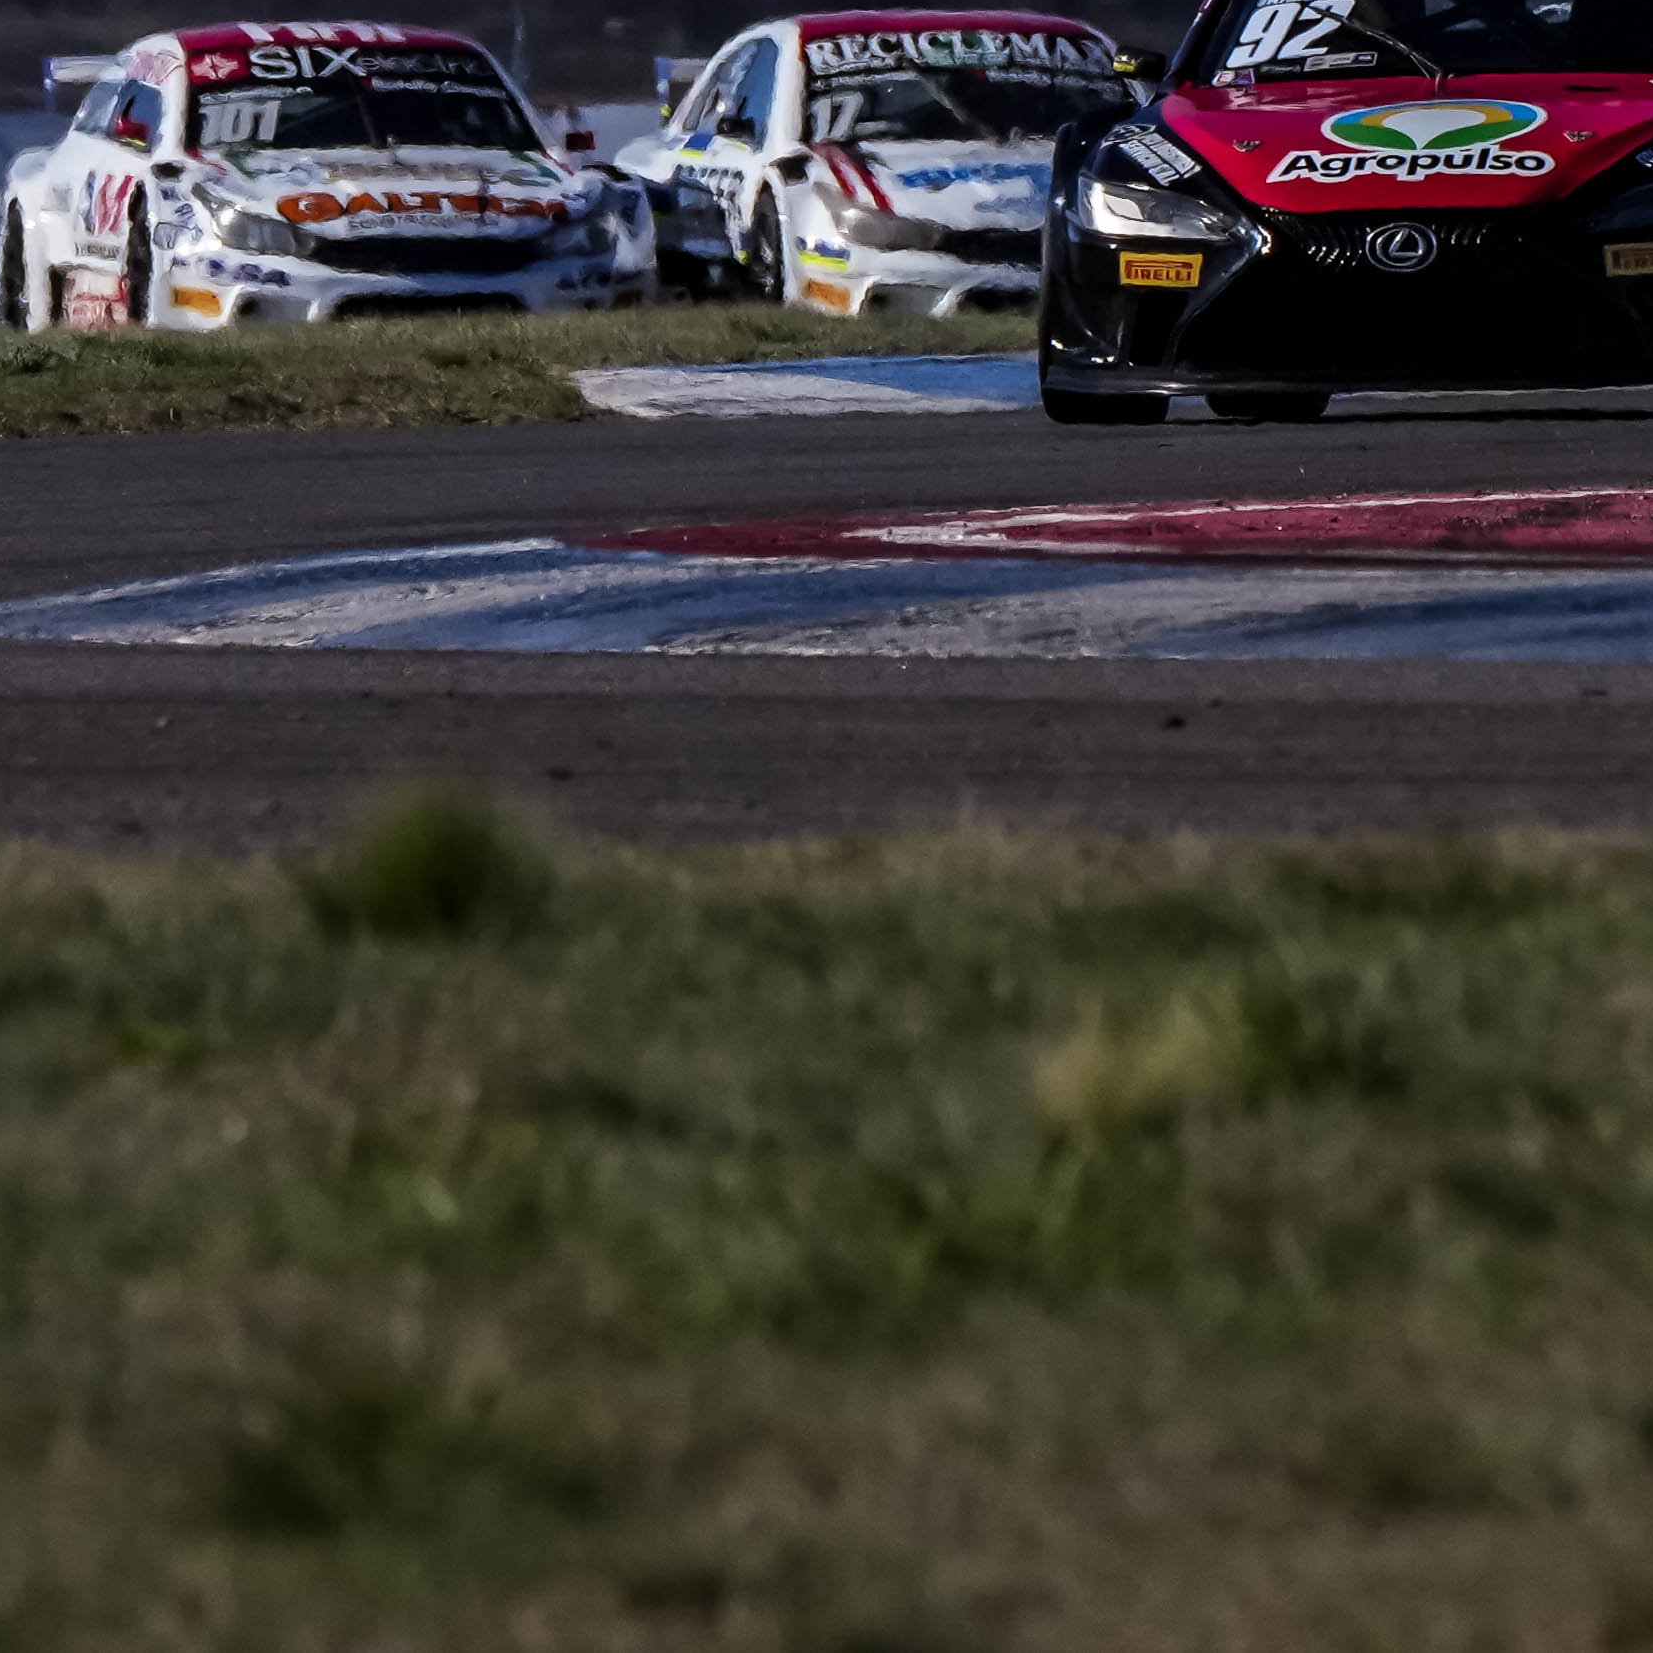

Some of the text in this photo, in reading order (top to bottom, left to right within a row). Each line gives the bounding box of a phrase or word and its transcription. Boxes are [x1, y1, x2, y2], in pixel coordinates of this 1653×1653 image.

[249, 46, 367, 79] SIX
[197, 100, 282, 145] 101
[808, 92, 864, 143] 17
[1124, 259, 1194, 282] PIRELLI
